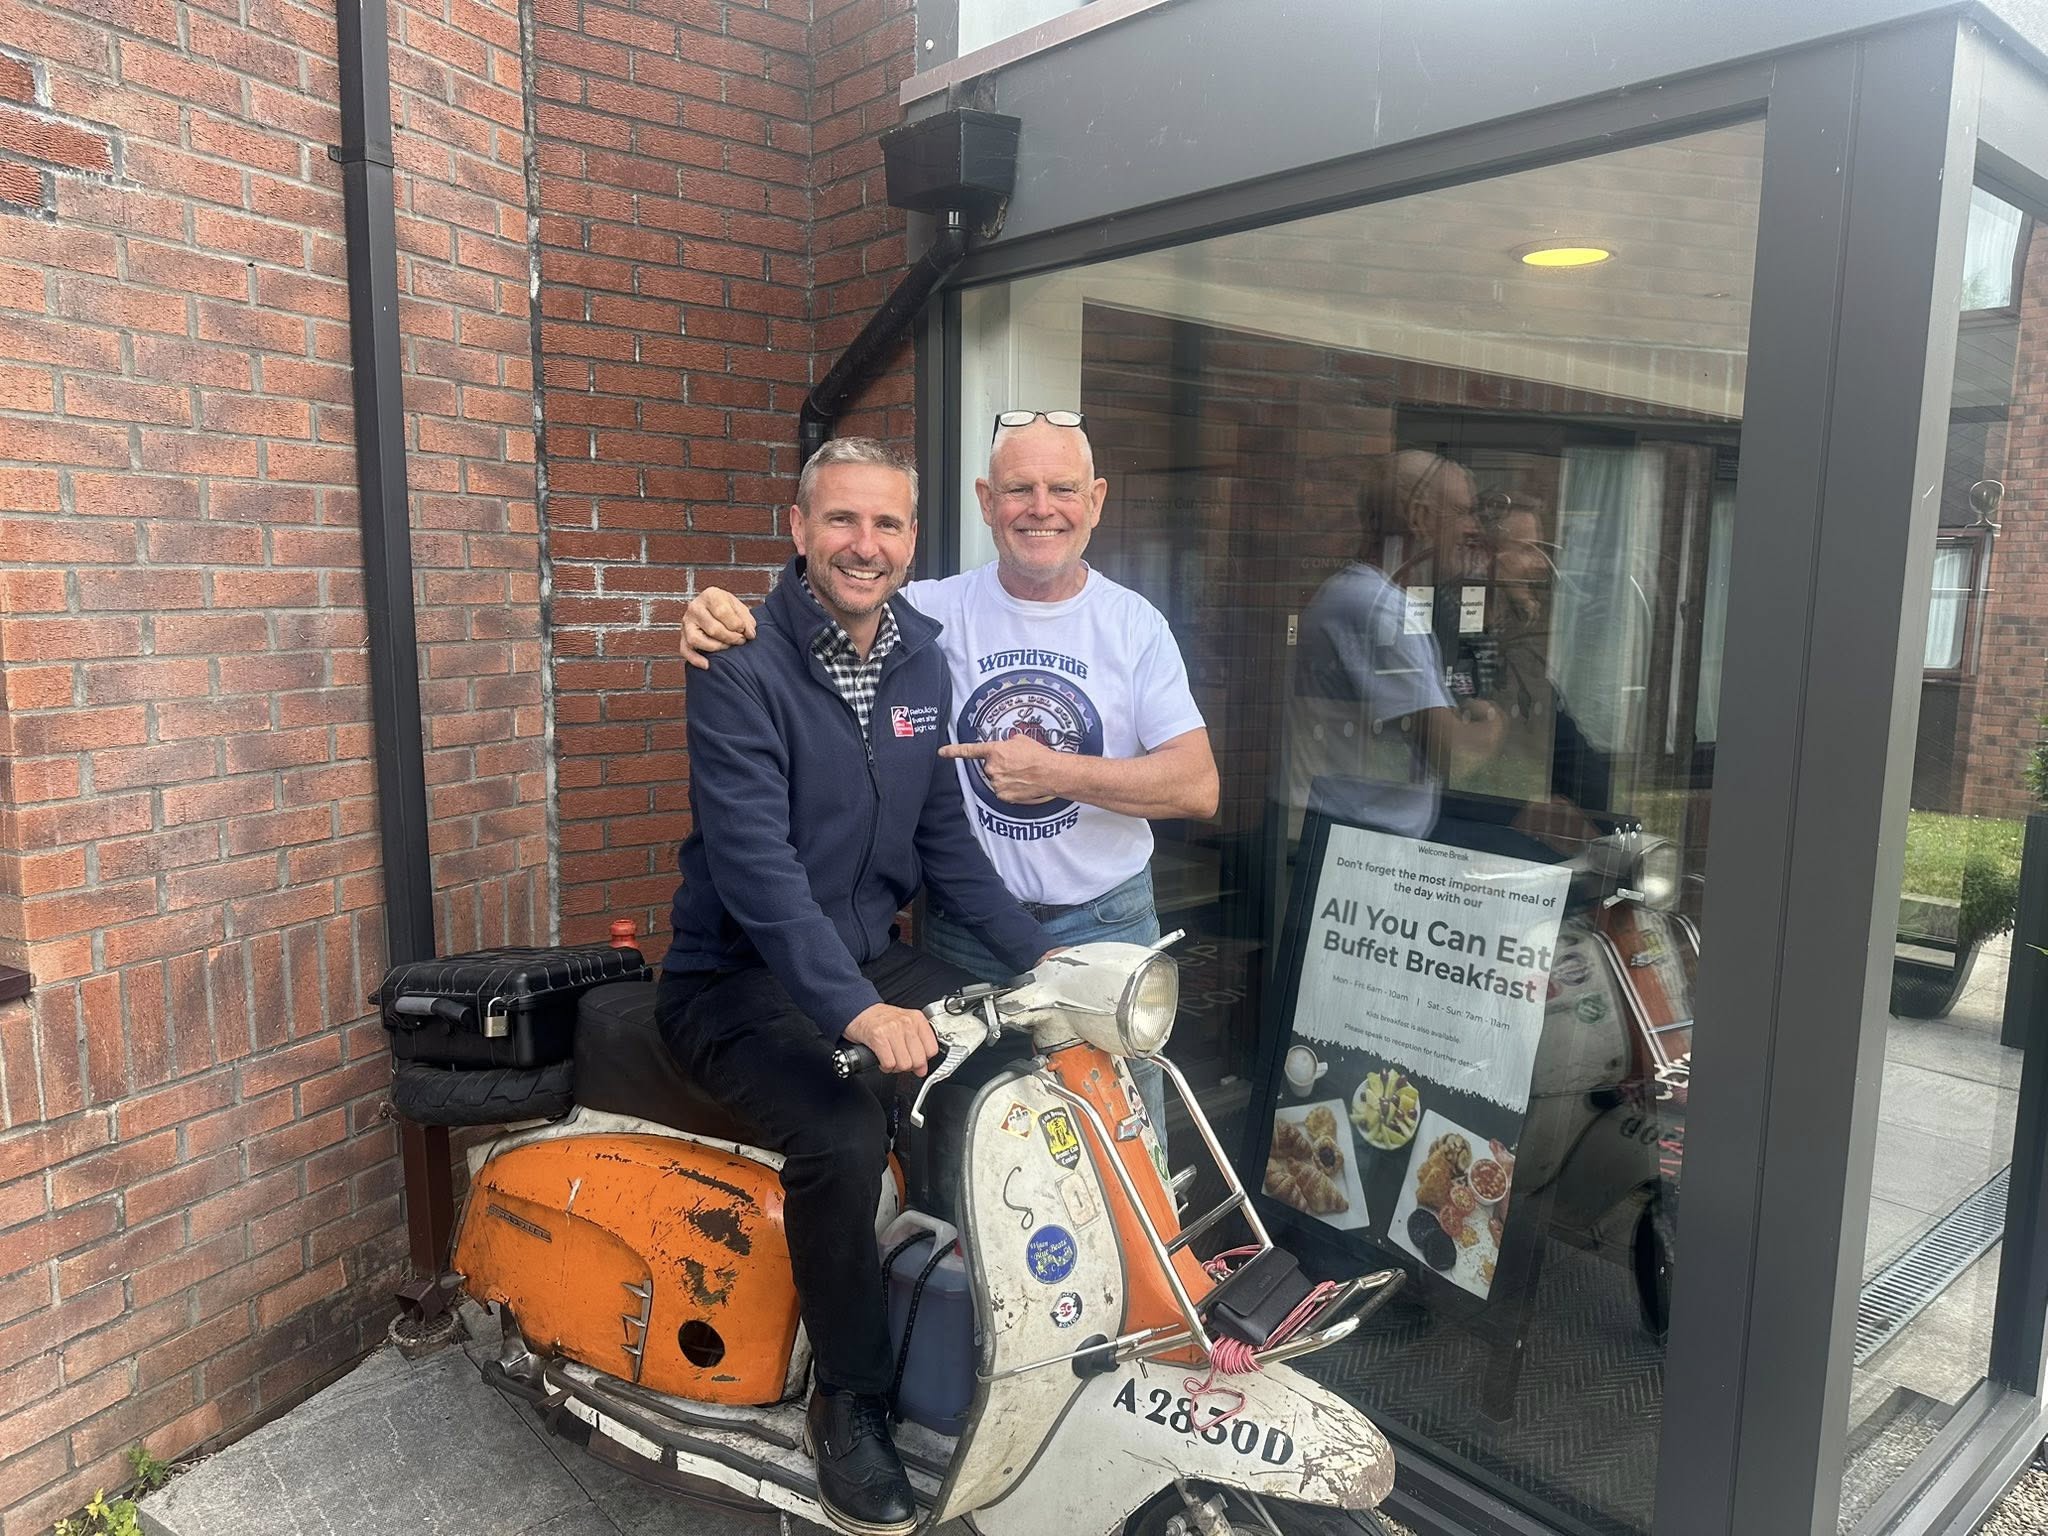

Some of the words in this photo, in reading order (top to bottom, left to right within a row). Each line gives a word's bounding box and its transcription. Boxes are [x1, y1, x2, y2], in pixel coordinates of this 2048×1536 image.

[977, 649, 1088, 679] Worldwide
[976, 805, 1080, 840] Members
[1418, 845, 1448, 858] Welcome
[1449, 850, 1469, 860] Break
[1336, 857, 1362, 870] Don't
[1365, 862, 1396, 876] forget
[1398, 869, 1416, 880] the
[1418, 874, 1446, 887] most
[1448, 877, 1505, 898] important
[1509, 891, 1540, 904] meal
[1542, 898, 1556, 907] of
[1394, 882, 1412, 894] the
[1414, 886, 1433, 900] day
[1436, 892, 1460, 904] with
[1463, 898, 1483, 908] our
[1320, 898, 1358, 926] All
[1366, 905, 1418, 940] You
[1428, 920, 1486, 956] Can
[1496, 935, 1552, 972] Eat
[1324, 929, 1398, 968] Buffet
[1406, 949, 1536, 1003] Breakfast
[1333, 974, 1349, 984] Mon
[1367, 984, 1383, 994] 6am
[1389, 990, 1408, 1001] 10am
[1427, 1001, 1439, 1010] Sat
[1465, 1011, 1483, 1023] 7am
[1490, 1018, 1510, 1030] 11am
[1344, 1023, 1364, 1034] Please
[1365, 1030, 1383, 1040] speak
[1392, 1039, 1422, 1053] reception
[1433, 1051, 1457, 1064] further
[1380, 1014, 1409, 1028] breakfast
[1417, 1026, 1430, 1035] also
